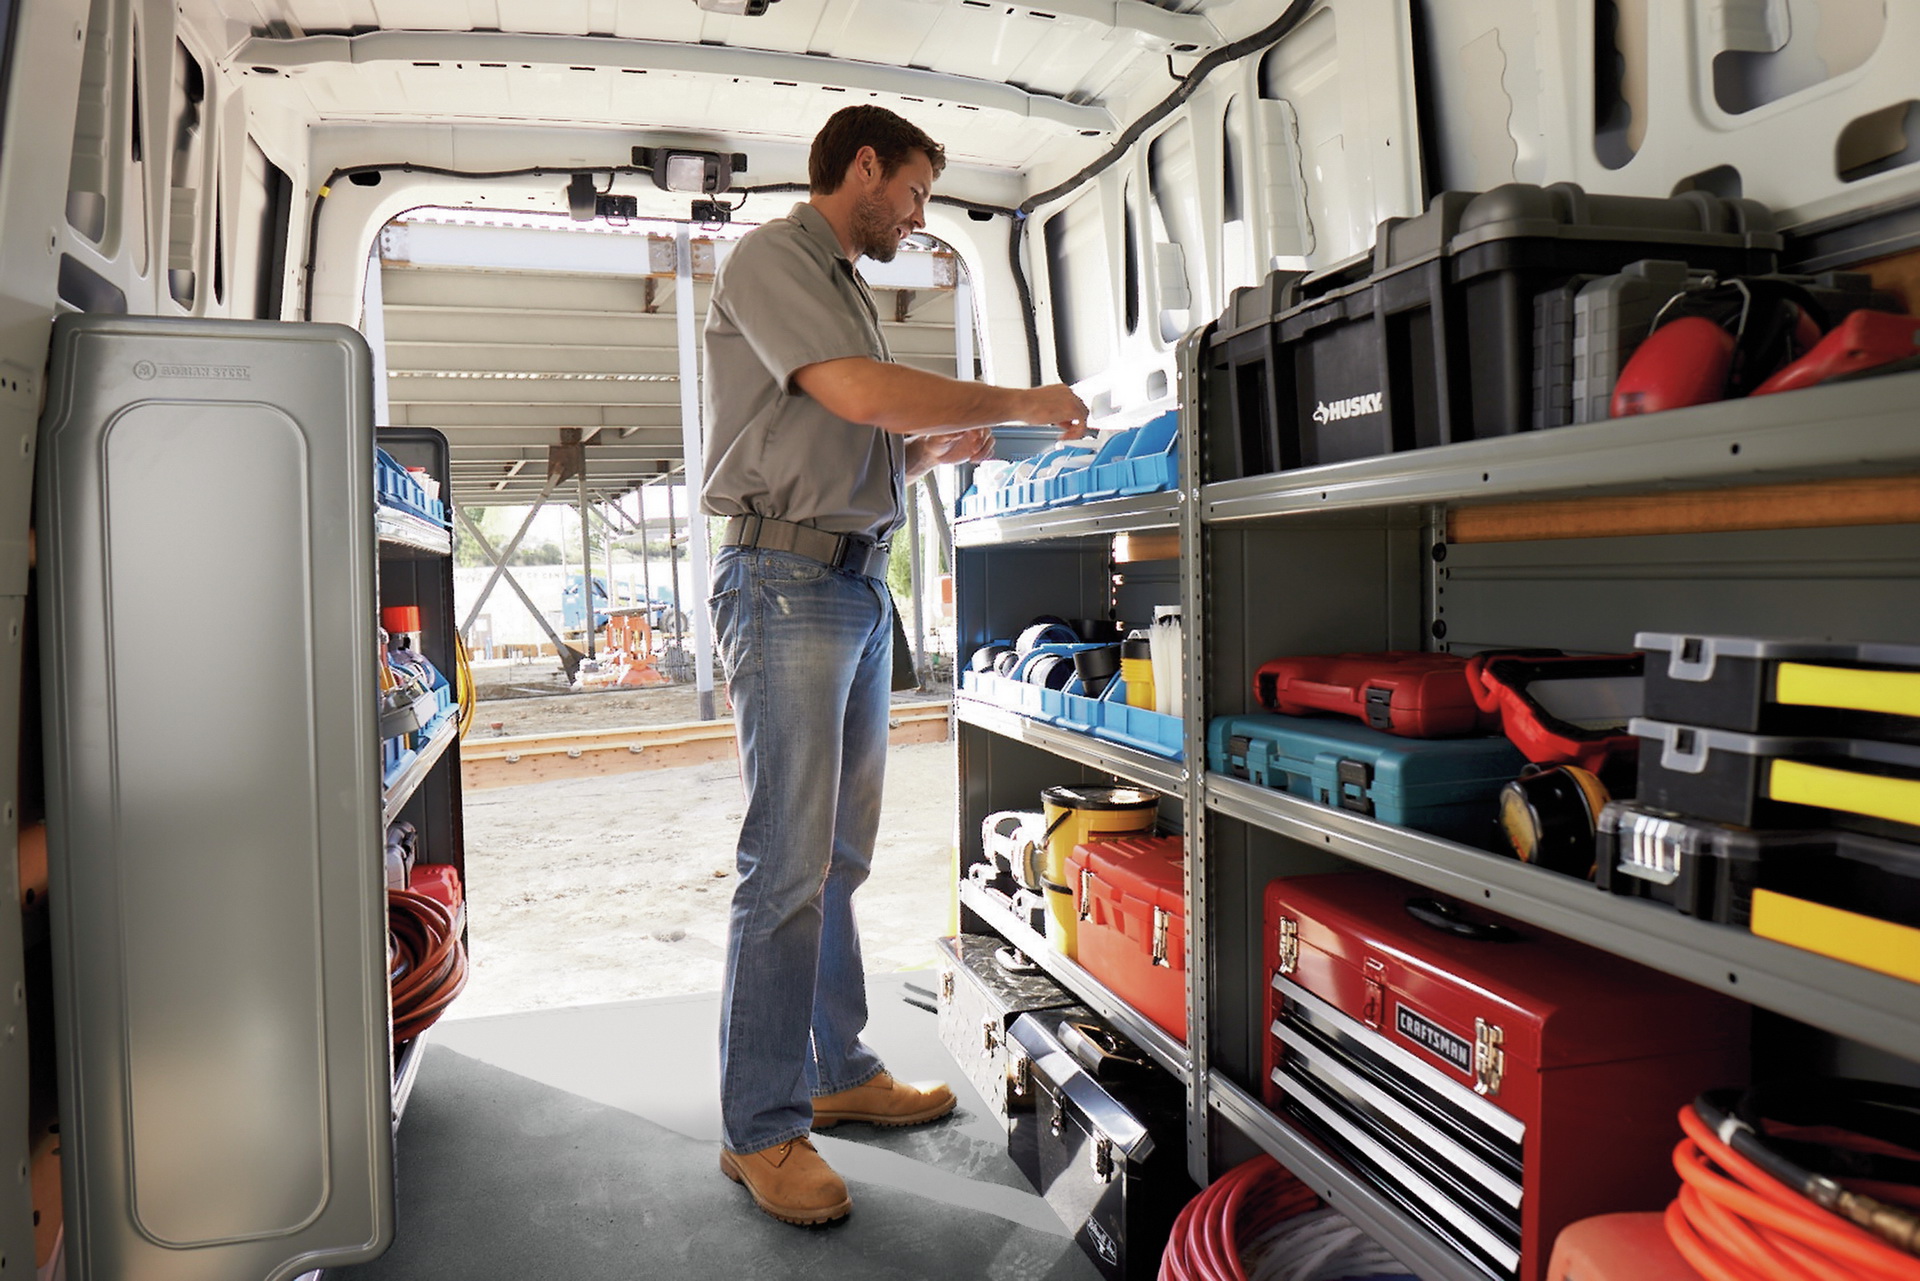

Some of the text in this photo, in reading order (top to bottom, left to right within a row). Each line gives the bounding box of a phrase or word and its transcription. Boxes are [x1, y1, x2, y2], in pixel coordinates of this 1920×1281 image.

[212, 367, 251, 378] STEEL
[1329, 391, 1382, 421] HUSKY
[1400, 1012, 1468, 1066] CRAFTSMAN
